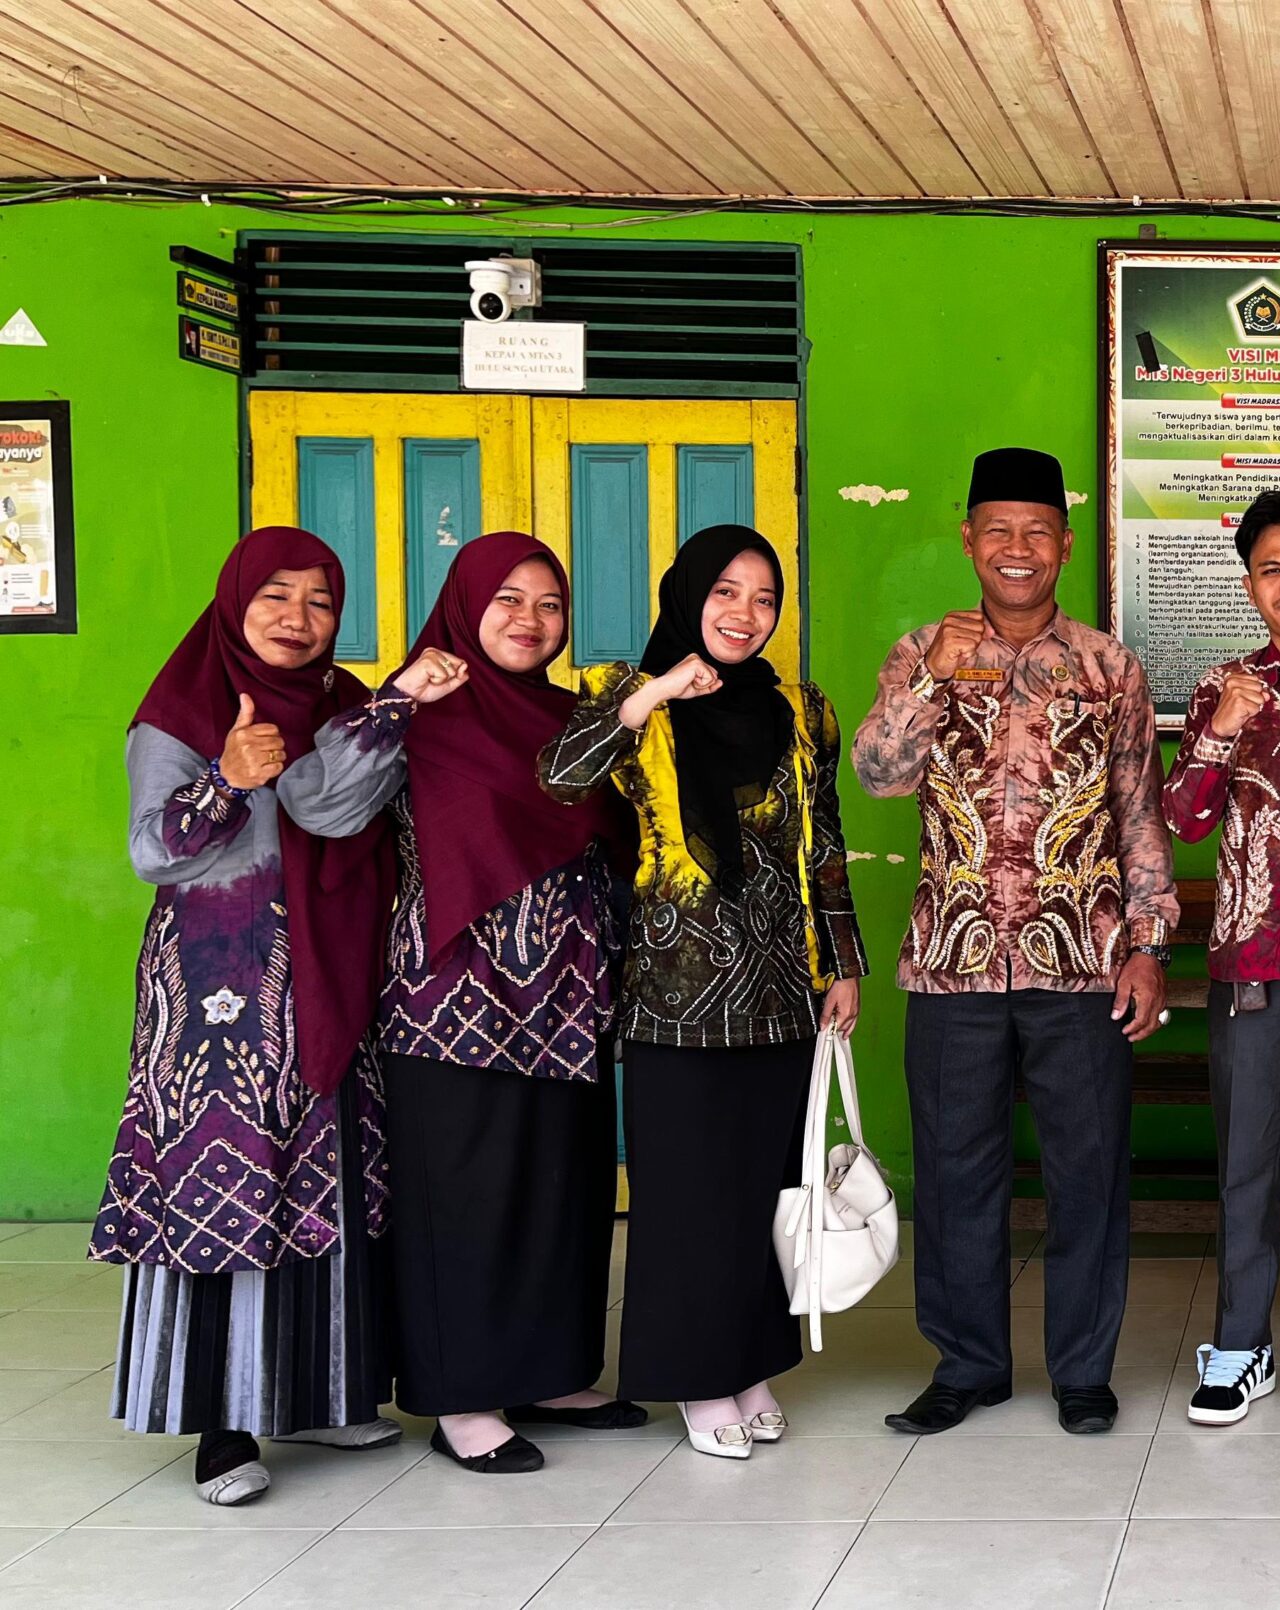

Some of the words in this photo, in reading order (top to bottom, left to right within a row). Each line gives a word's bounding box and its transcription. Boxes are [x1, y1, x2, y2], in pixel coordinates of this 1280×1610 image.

[498, 336, 549, 347] RUANG
[1228, 349, 1260, 362] VISI
[540, 365, 574, 374] UTARA
[1173, 367, 1226, 383] Negeri
[1231, 368, 1240, 381] 3
[1214, 412, 1239, 420] siswa
[1241, 414, 1262, 423] yang
[1139, 432, 1224, 442] mengaktualisasikan
[1227, 433, 1242, 441] diri
[1244, 433, 1270, 442] dalam
[1173, 473, 1234, 483] Meningkatkan
[1159, 483, 1220, 493] Meningkatkan
[1222, 484, 1252, 492] Sarana
[1148, 534, 1192, 542] Mewujudkan
[1209, 543, 1236, 551] organis
[1148, 559, 1205, 567] Memberdayakan
[1148, 575, 1208, 583] Mengembangkan
[1148, 583, 1192, 591] Mewujudkan
[1148, 591, 1205, 599] Memberdayakan
[1148, 599, 1197, 607] Meningkatkan
[1148, 614, 1197, 622] Meningkatkan
